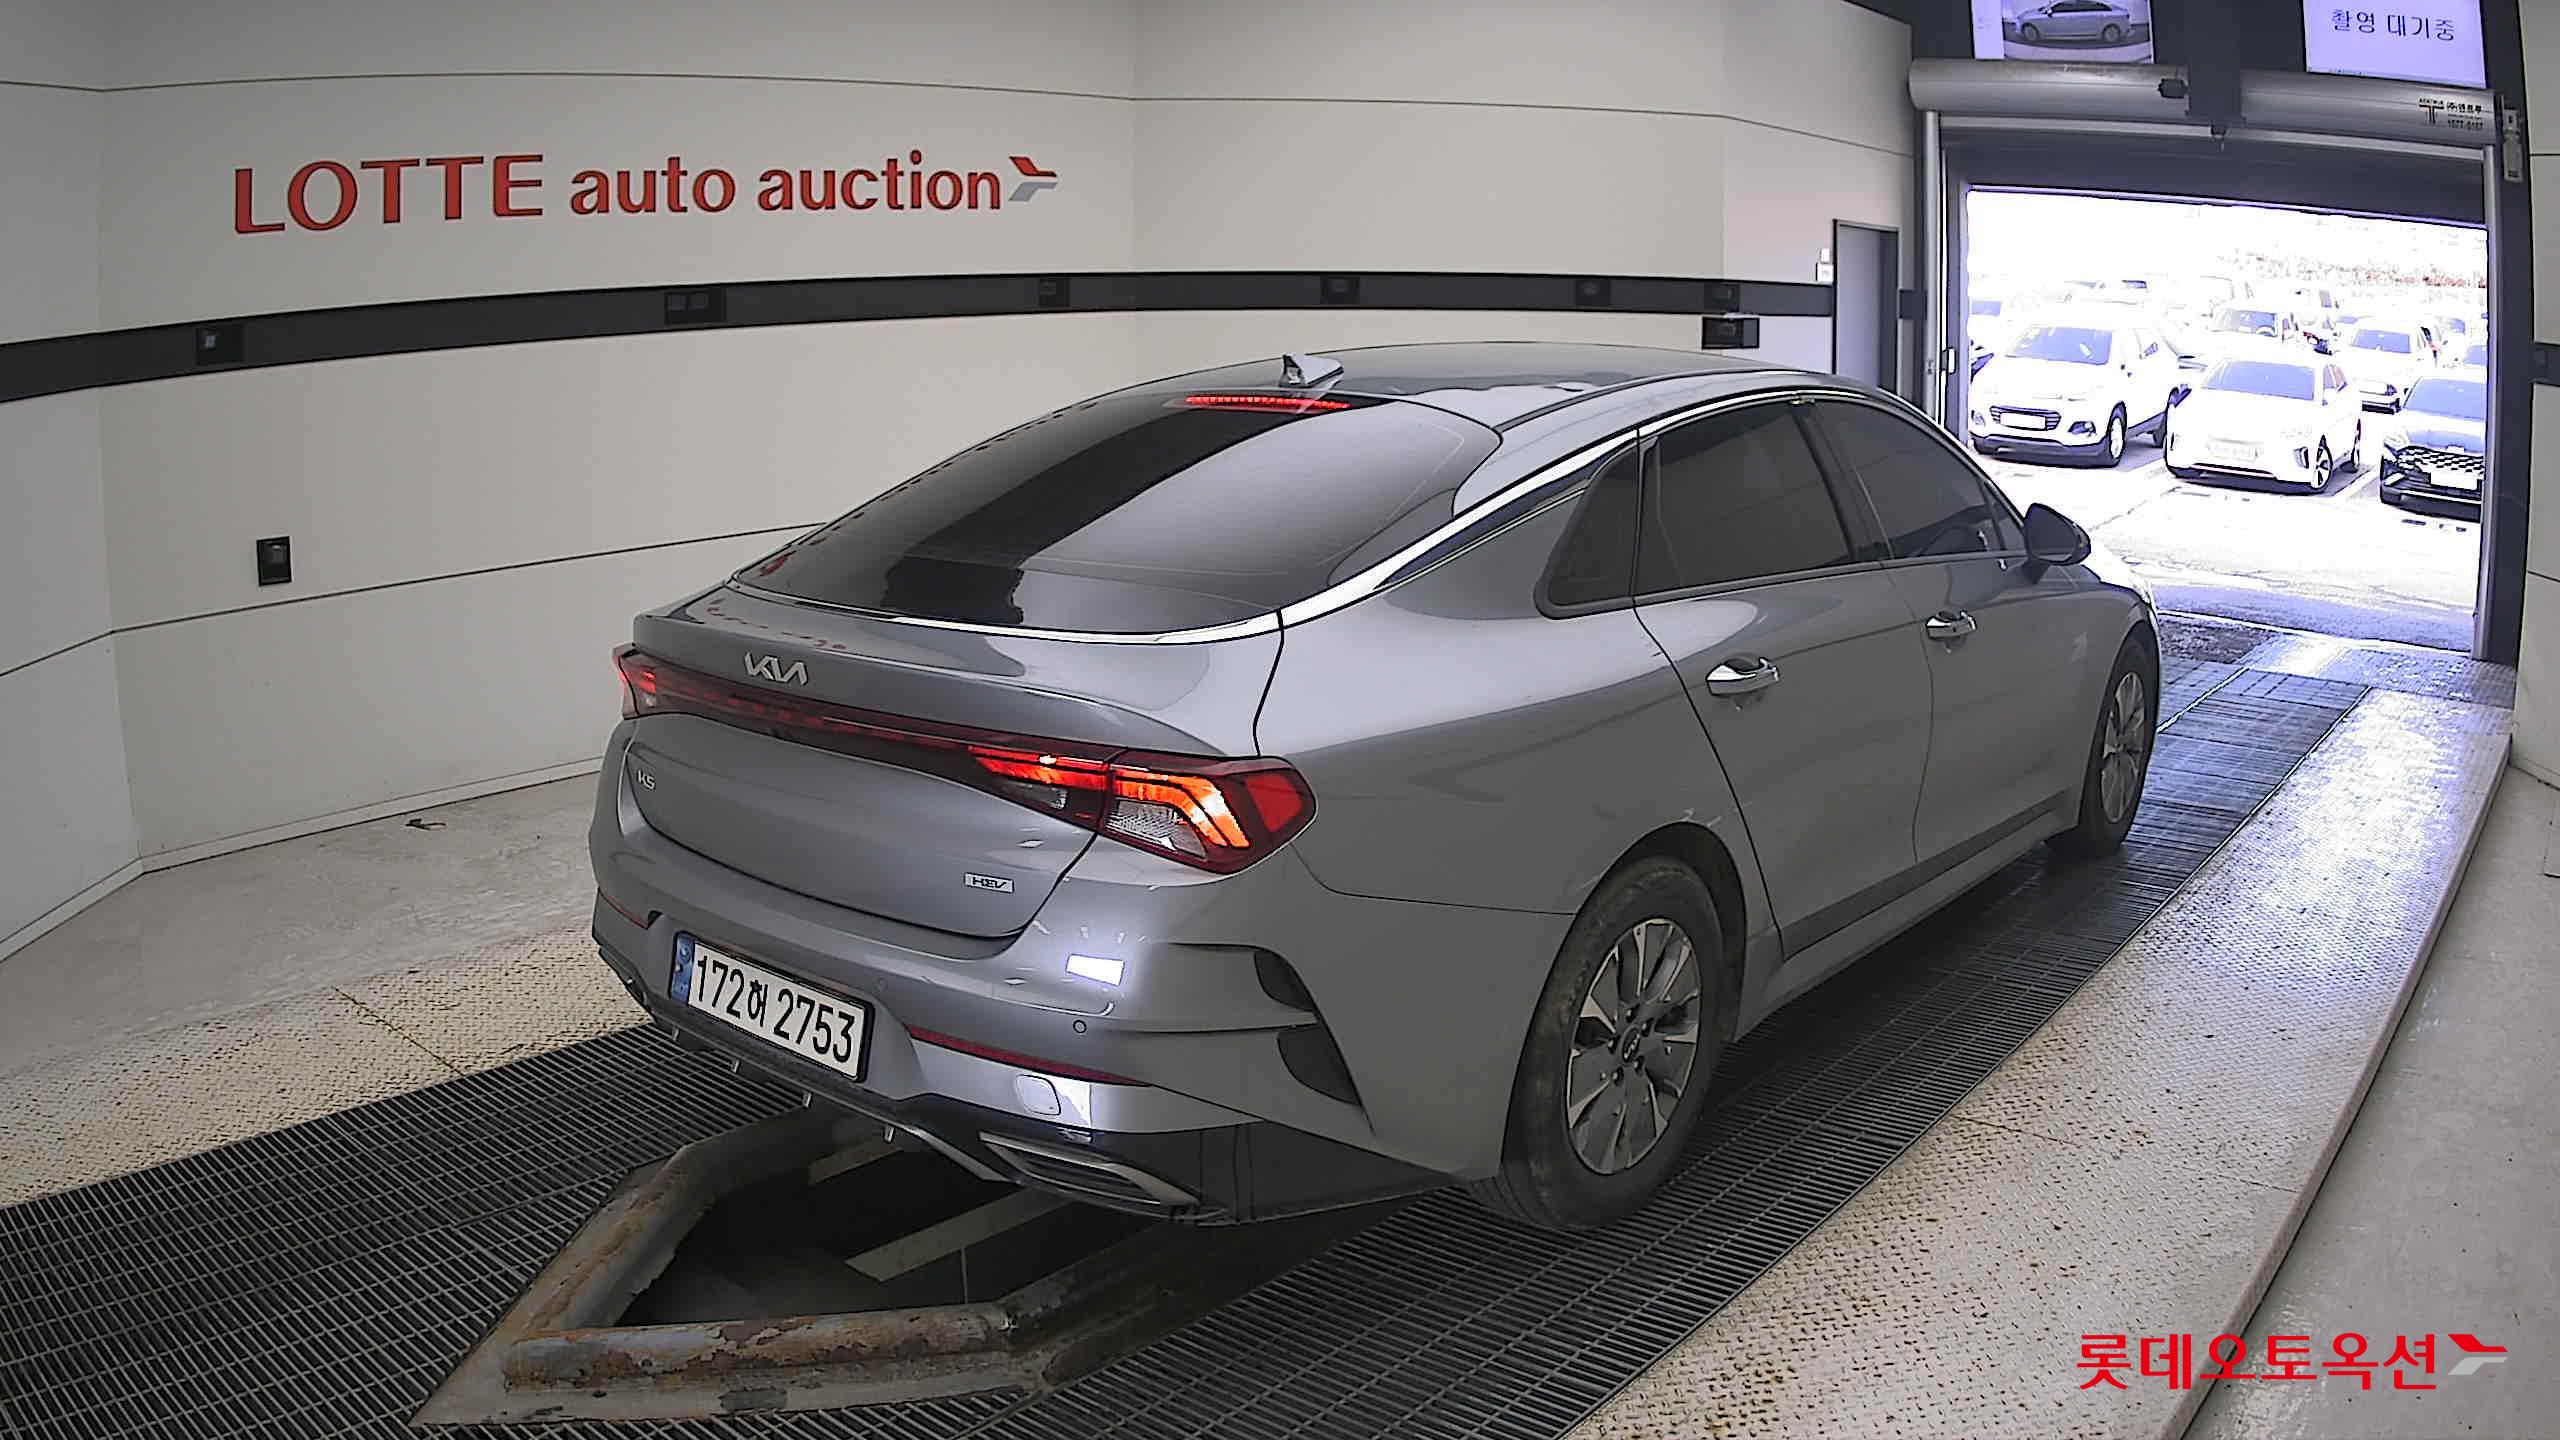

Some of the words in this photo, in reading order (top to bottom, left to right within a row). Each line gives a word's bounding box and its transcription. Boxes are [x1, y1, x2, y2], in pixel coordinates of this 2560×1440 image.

[2332, 9, 2375, 33] 촬영
[2388, 15, 2454, 41] 대기중
[234, 154, 543, 234] LOTTE
[569, 156, 736, 215] auto
[758, 150, 1001, 211] auction
[773, 988, 855, 1062] 2753
